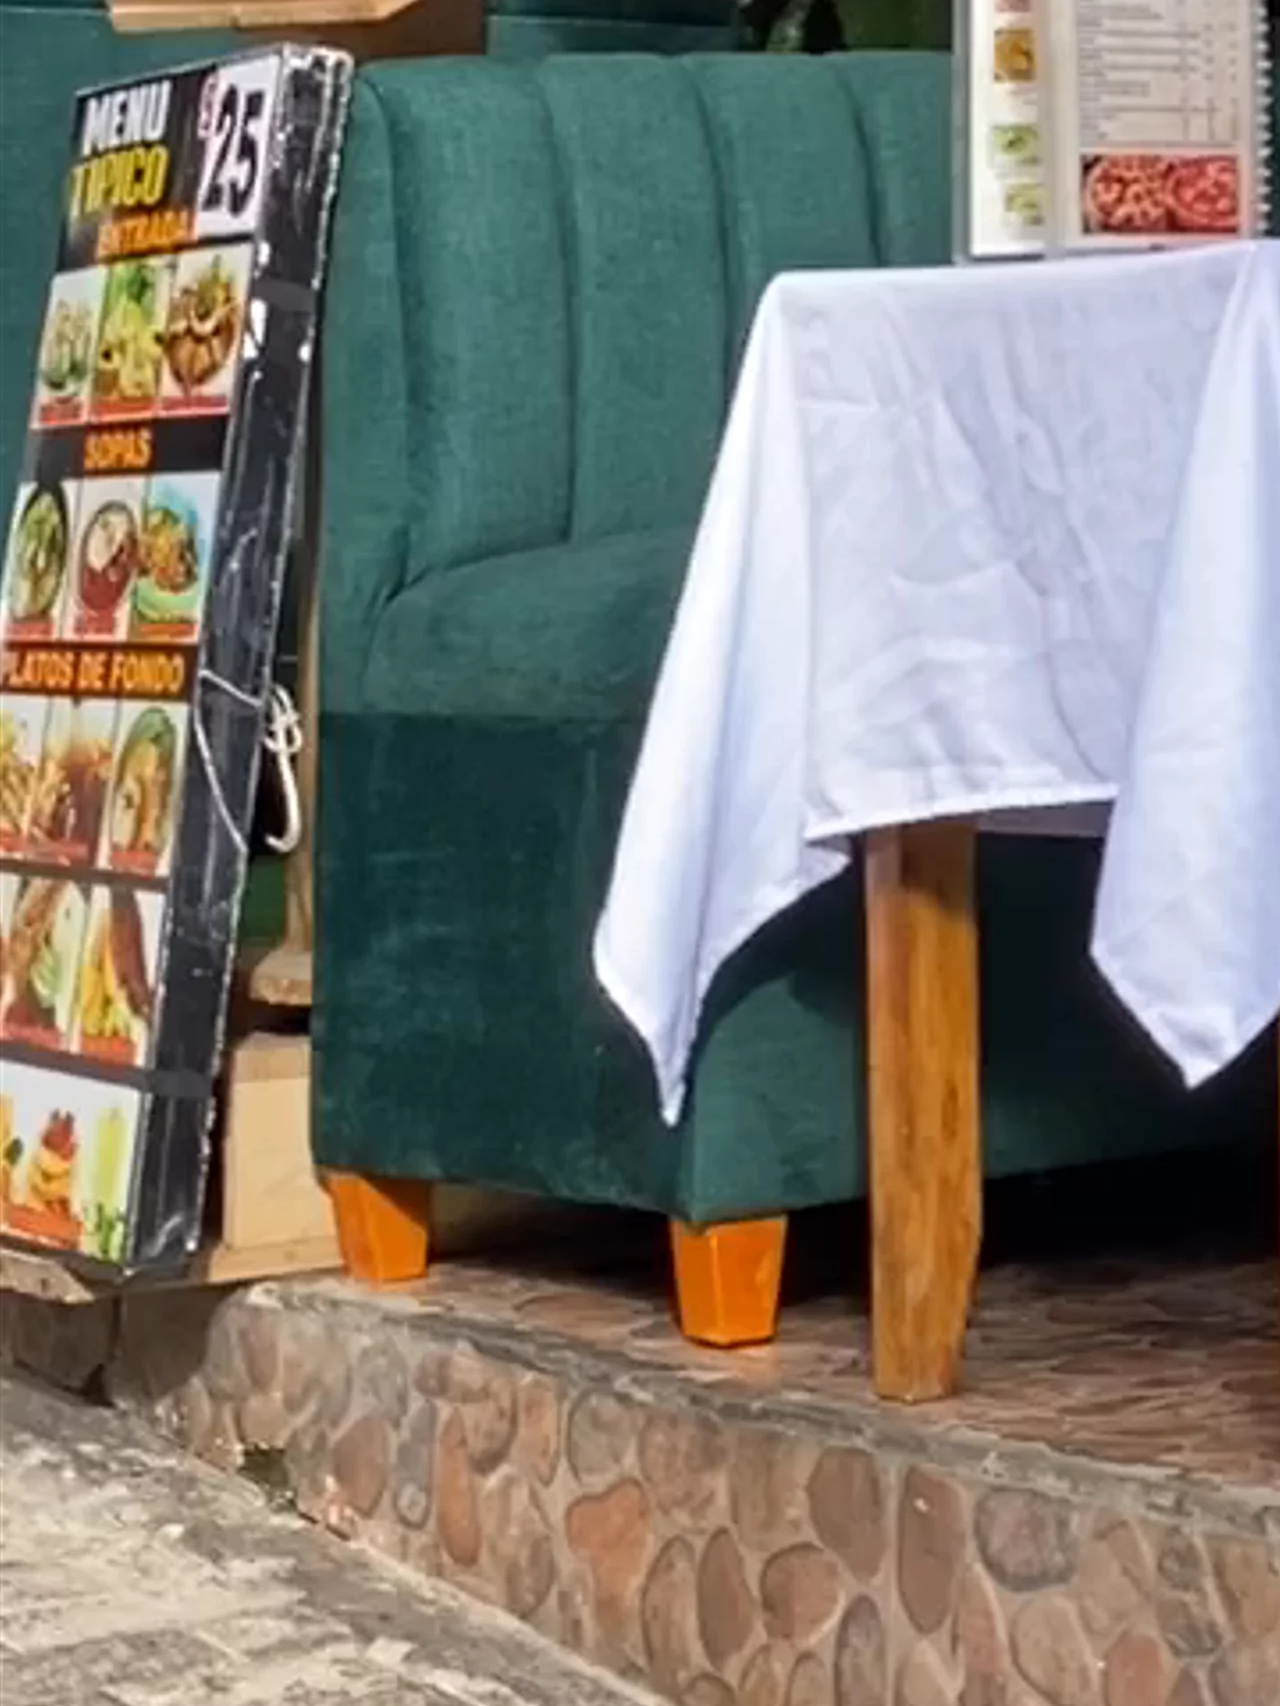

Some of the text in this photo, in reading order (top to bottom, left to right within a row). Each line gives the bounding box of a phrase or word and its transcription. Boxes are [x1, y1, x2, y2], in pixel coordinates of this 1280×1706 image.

[83, 80, 172, 154] MENU
[203, 85, 264, 220] 25
[68, 144, 169, 217] TIPICO
[83, 426, 153, 470] SOPAS
[78, 651, 108, 690] DE
[111, 651, 185, 693] FONDO
